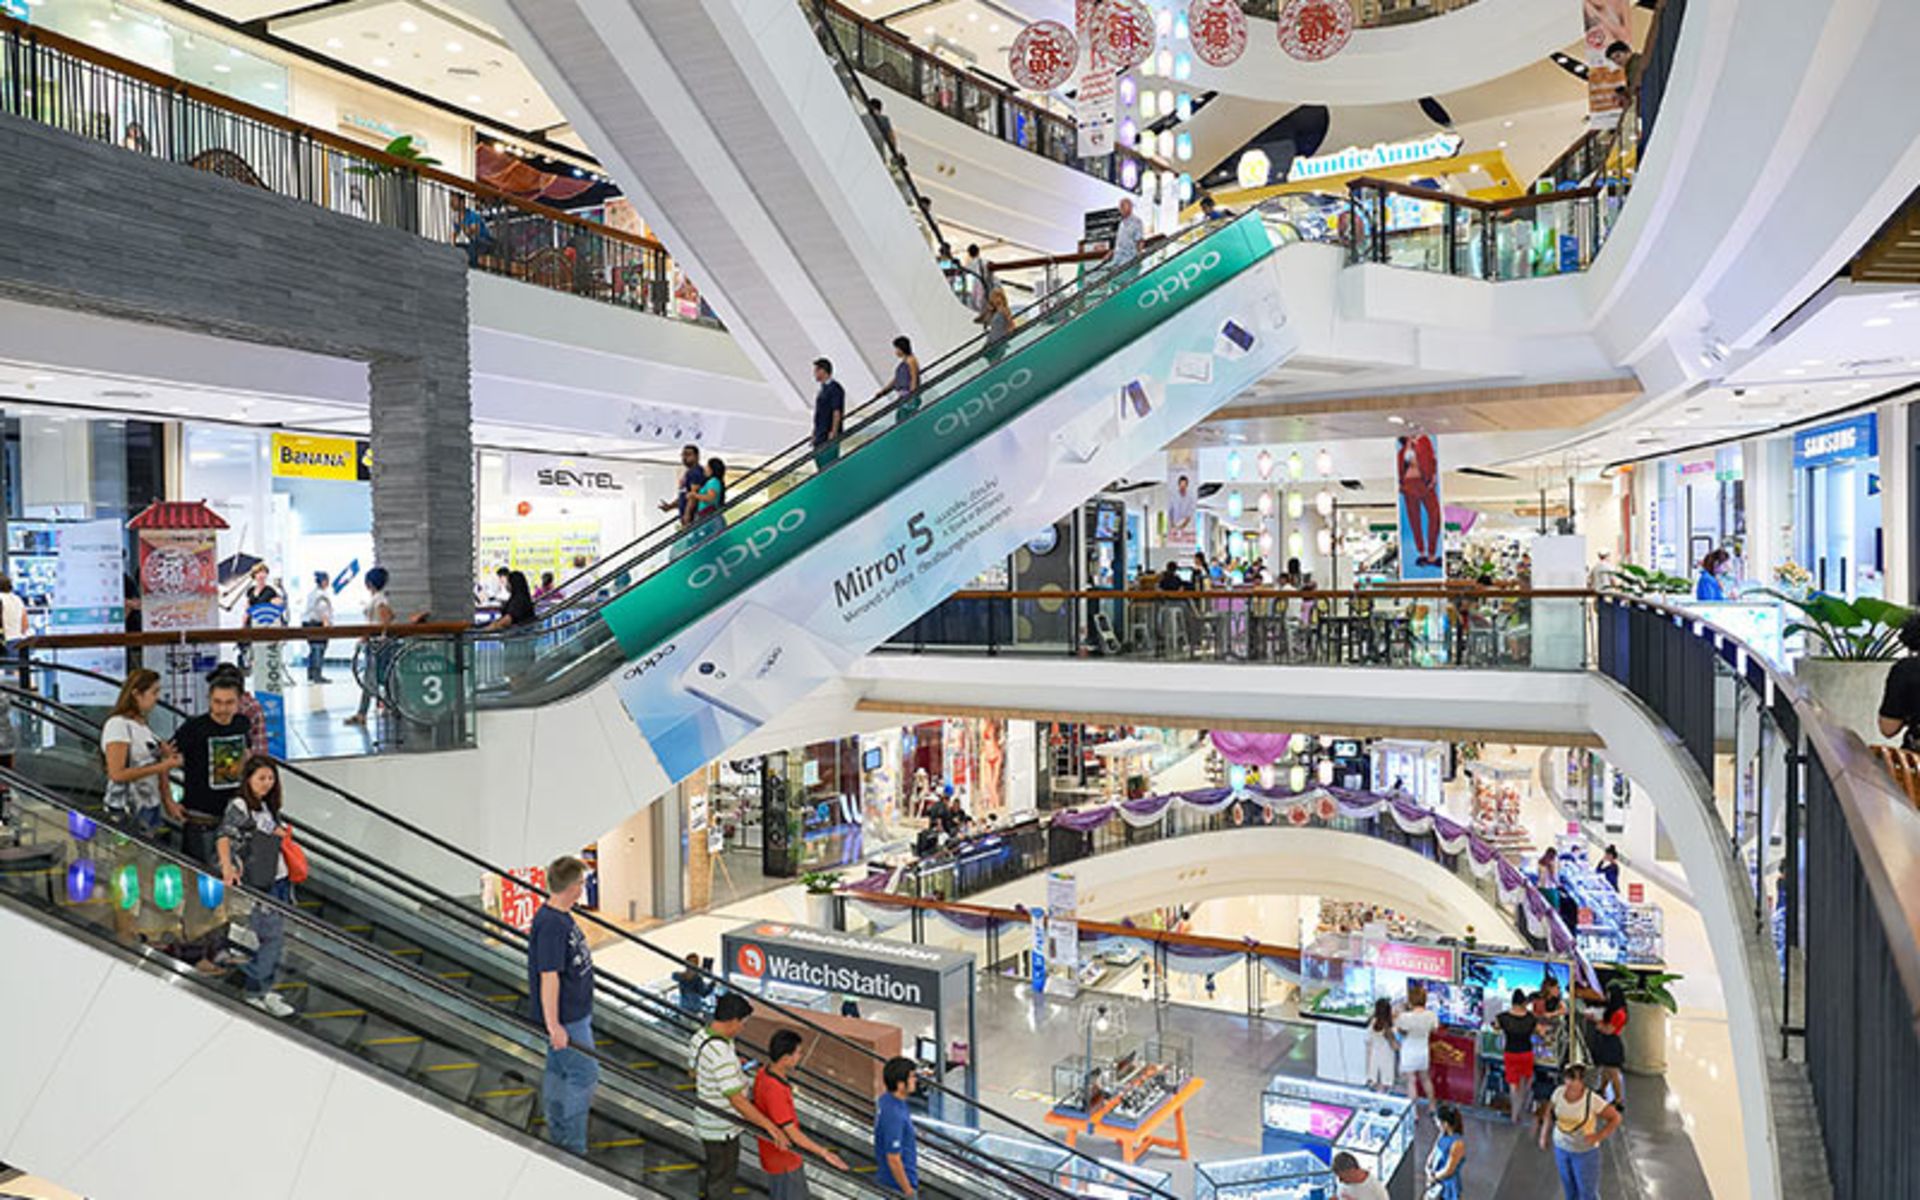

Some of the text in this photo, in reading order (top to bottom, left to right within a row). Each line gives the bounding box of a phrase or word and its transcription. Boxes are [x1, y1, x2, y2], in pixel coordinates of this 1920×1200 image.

[1137, 251, 1221, 308] oppo
[933, 368, 1032, 436] oppo
[1804, 427, 1856, 459] SAMSUNG
[537, 469, 624, 490] SENTEL
[688, 508, 807, 588] oppo
[833, 543, 906, 608] Mirror
[907, 511, 934, 556] 5
[623, 644, 676, 680] oppo
[422, 675, 443, 705] 3
[768, 955, 921, 1003] WatchStation
